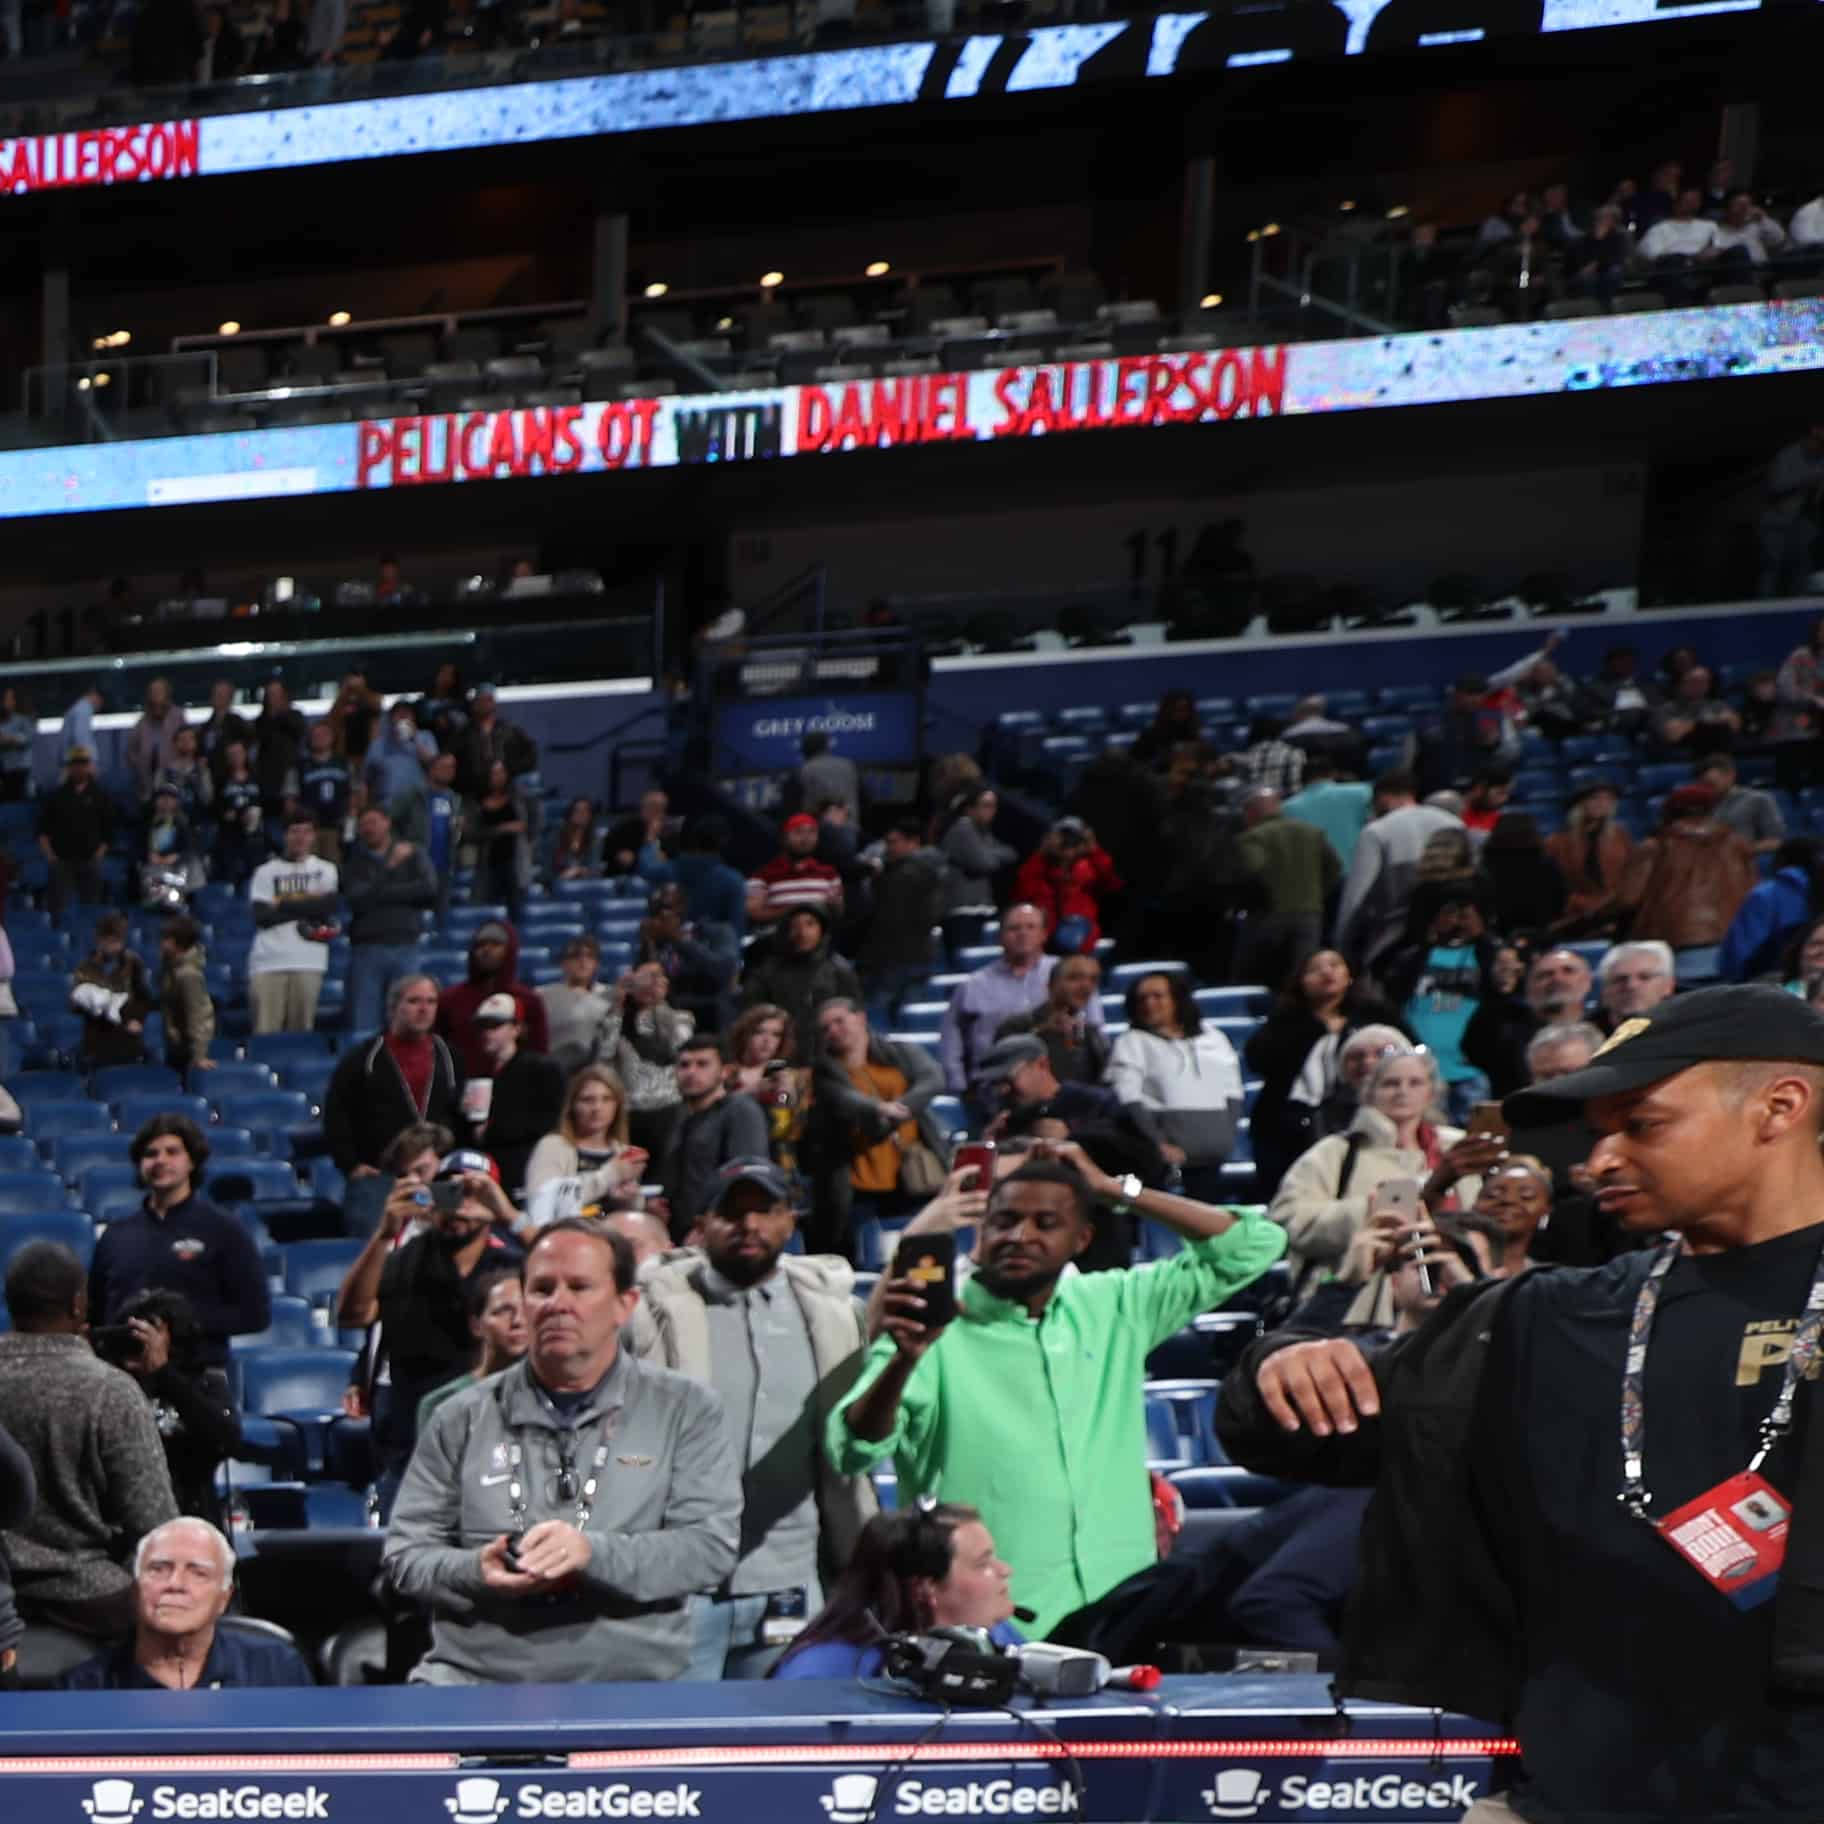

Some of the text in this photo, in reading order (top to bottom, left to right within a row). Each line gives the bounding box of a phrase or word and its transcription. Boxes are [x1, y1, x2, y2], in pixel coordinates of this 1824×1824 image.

[357, 406, 586, 487] PELICANS
[598, 400, 660, 468] OT
[796, 375, 977, 452] DANIEL
[992, 347, 1287, 435] SALLERSON
[152, 1783, 329, 1821] SeatGeek
[517, 1783, 701, 1819] SeatGeek
[895, 1781, 1080, 1817] SeatGeek
[1280, 1774, 1479, 1810] SeatGeek
